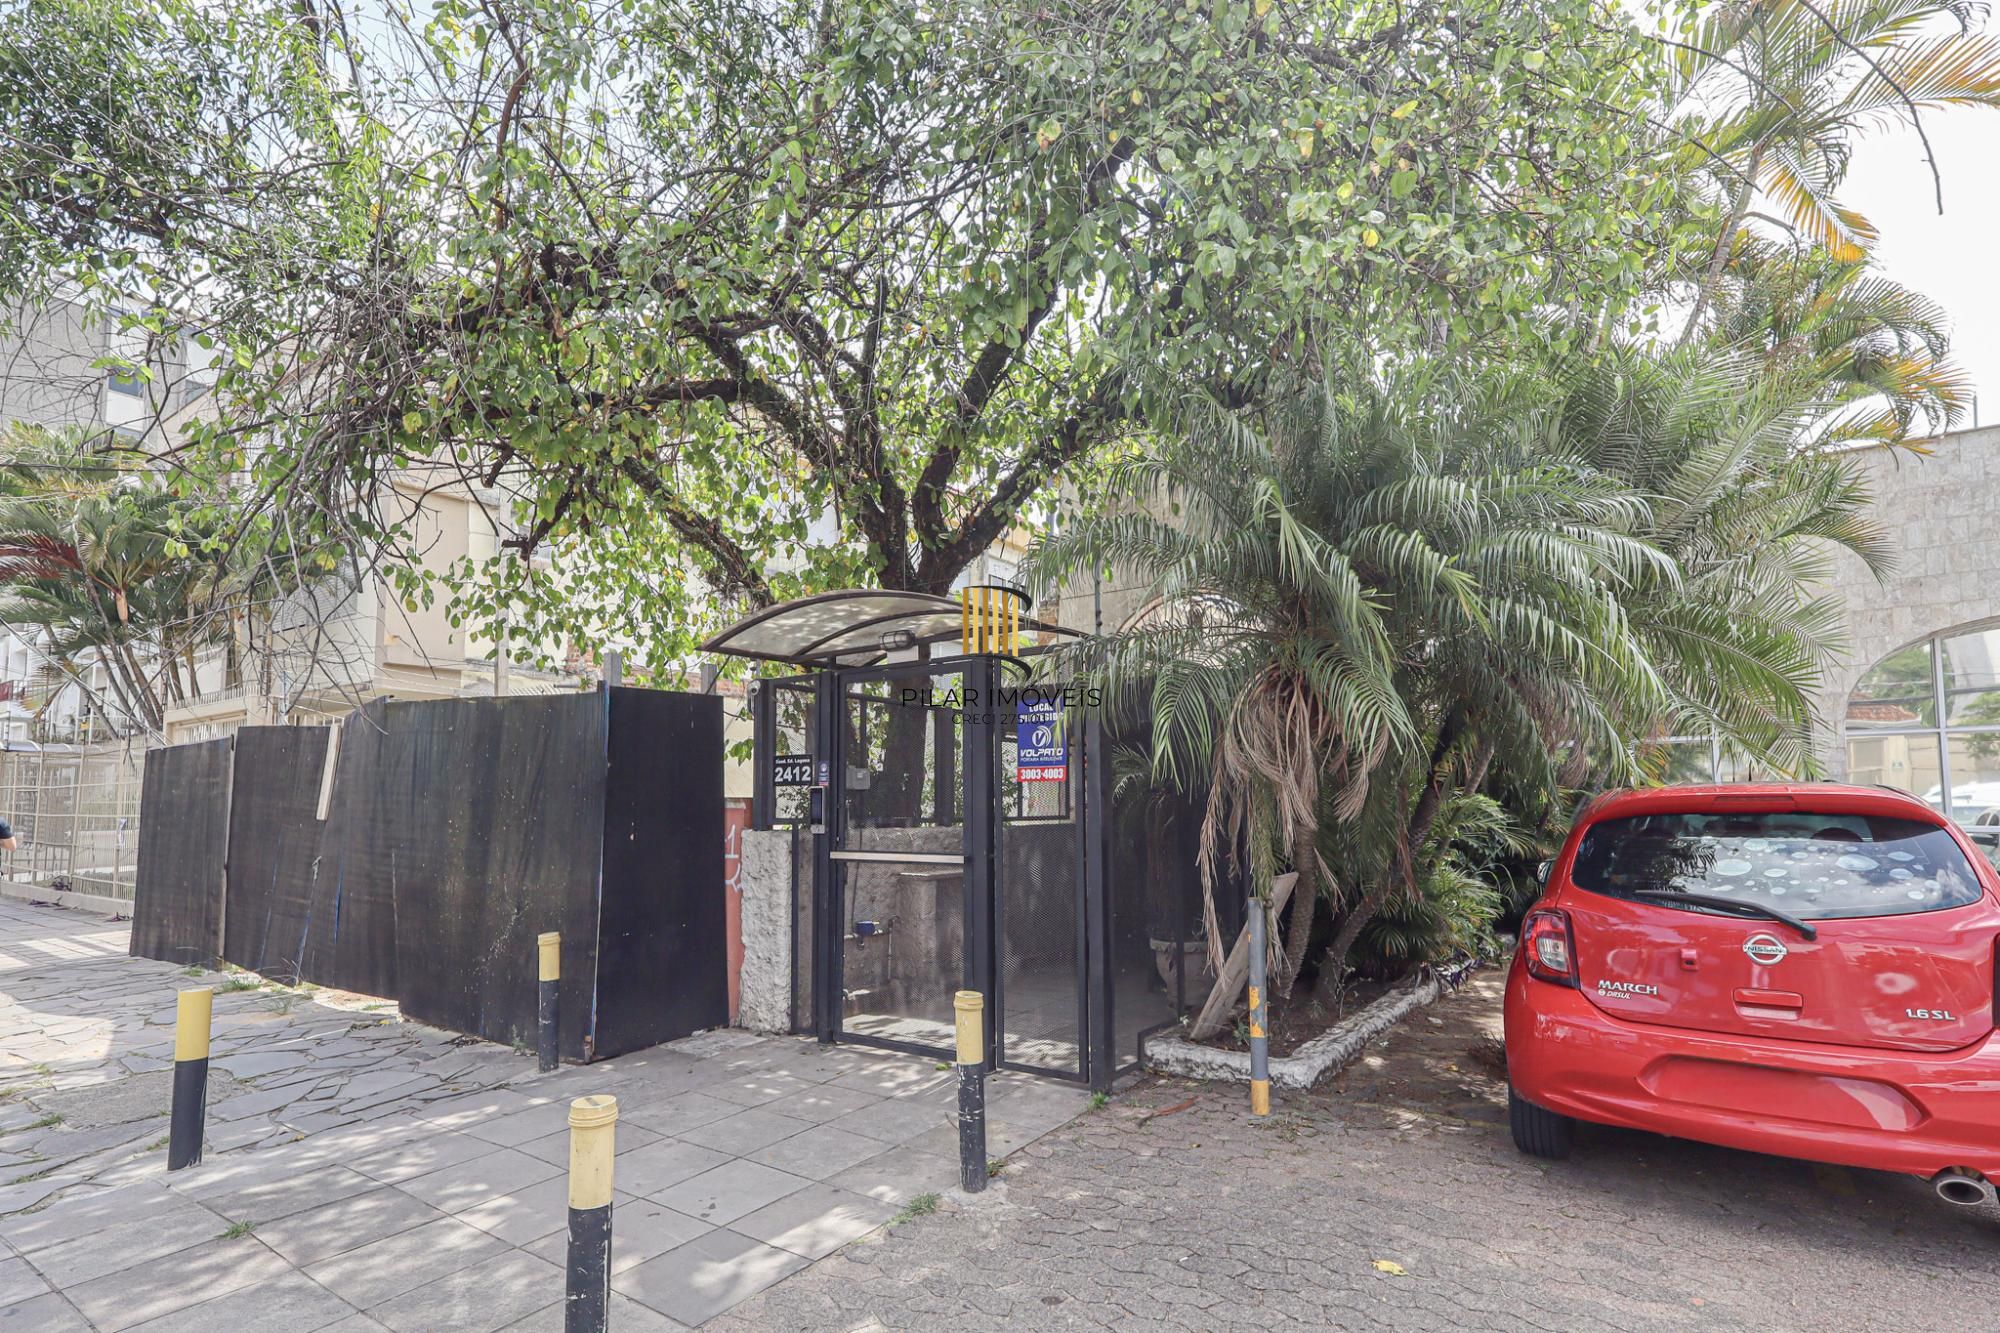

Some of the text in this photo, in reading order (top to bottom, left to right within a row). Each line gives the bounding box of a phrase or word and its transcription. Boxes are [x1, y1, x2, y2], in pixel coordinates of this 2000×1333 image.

[1029, 702, 1054, 713] LOCAL
[1020, 748, 1064, 758] VOLPATO
[774, 765, 812, 782] 2412
[1020, 768, 1064, 780] 3003-4003
[1747, 945, 1783, 954] NISSAN
[1598, 979, 1658, 996] MARCH
[1931, 1009, 1957, 1021] SL
